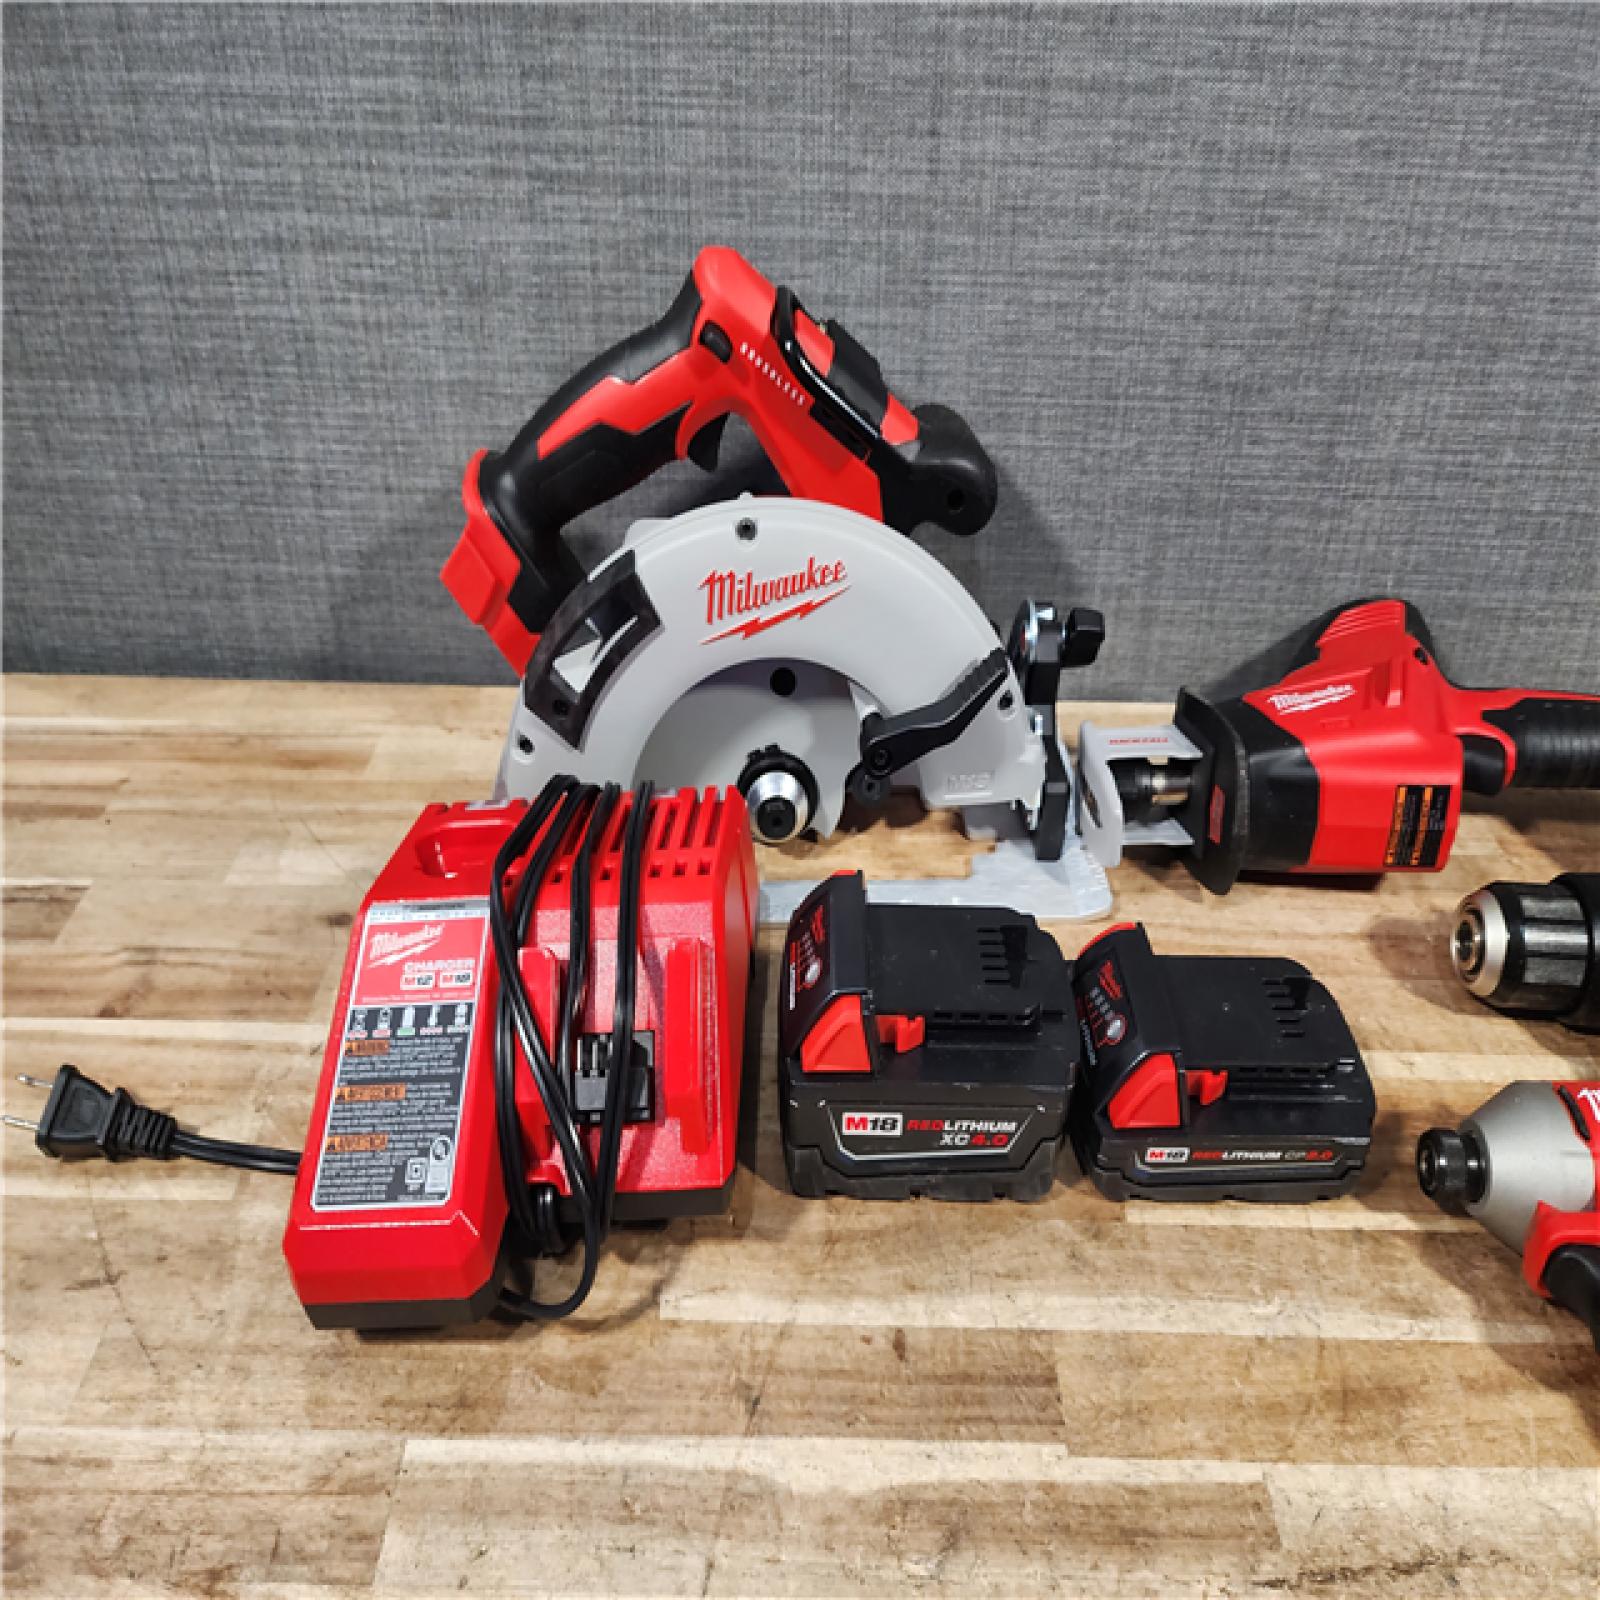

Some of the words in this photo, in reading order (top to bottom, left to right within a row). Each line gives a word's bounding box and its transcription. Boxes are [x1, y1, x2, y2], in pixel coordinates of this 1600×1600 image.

[698, 554, 849, 626] Milwaukee
[844, 1115, 900, 1133] M18
[907, 1119, 1017, 1132] REDLITHIUM
